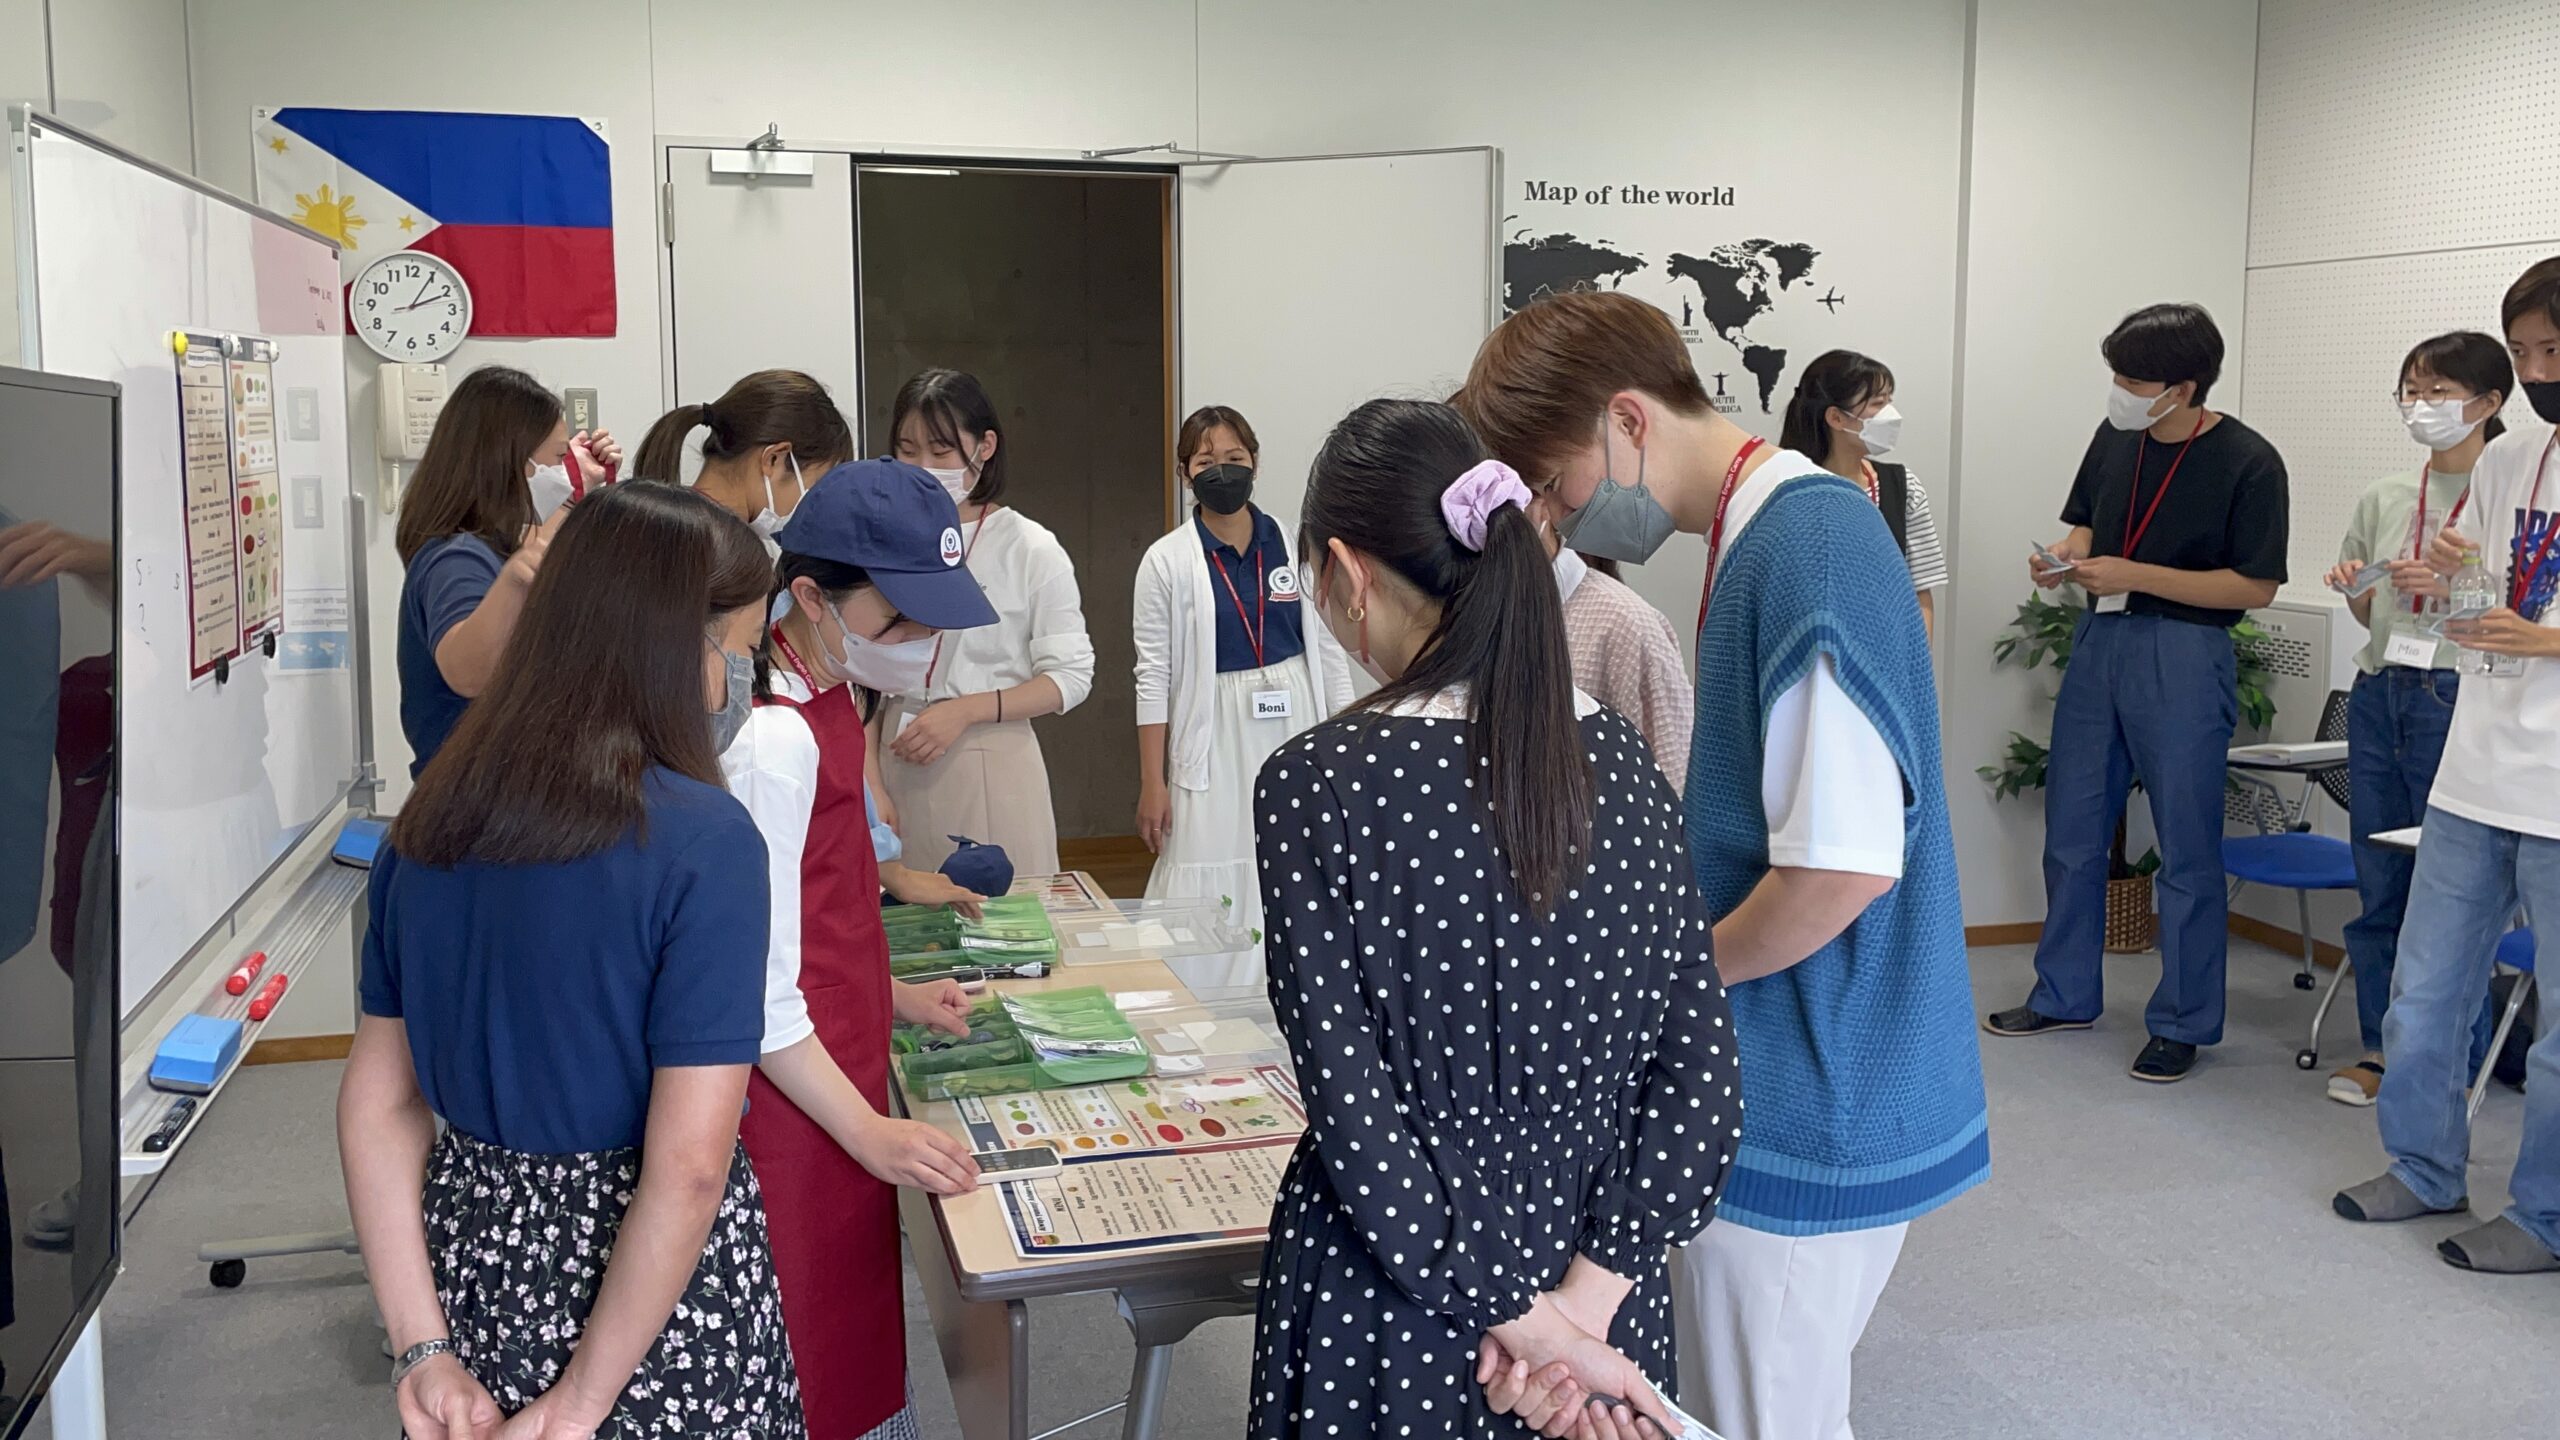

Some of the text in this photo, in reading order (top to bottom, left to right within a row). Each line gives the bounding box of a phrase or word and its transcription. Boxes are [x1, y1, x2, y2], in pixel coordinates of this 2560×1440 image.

[1525, 181, 1734, 206] Map of the world
[388, 270, 400, 282] 11
[404, 265, 420, 278] 12
[429, 271, 436, 283] 1
[373, 282, 389, 295] 10
[441, 285, 451, 297] 2
[366, 299, 376, 311] 9
[448, 303, 457, 316] 3
[373, 317, 382, 330] 8
[440, 321, 450, 333] 4
[387, 331, 398, 343] 7
[427, 334, 435, 346] 5
[406, 337, 416, 350] 6
[1712, 396, 1735, 405] OUTH
[1258, 703, 1285, 712] Boni
[1051, 1197, 1065, 1212] MENU
